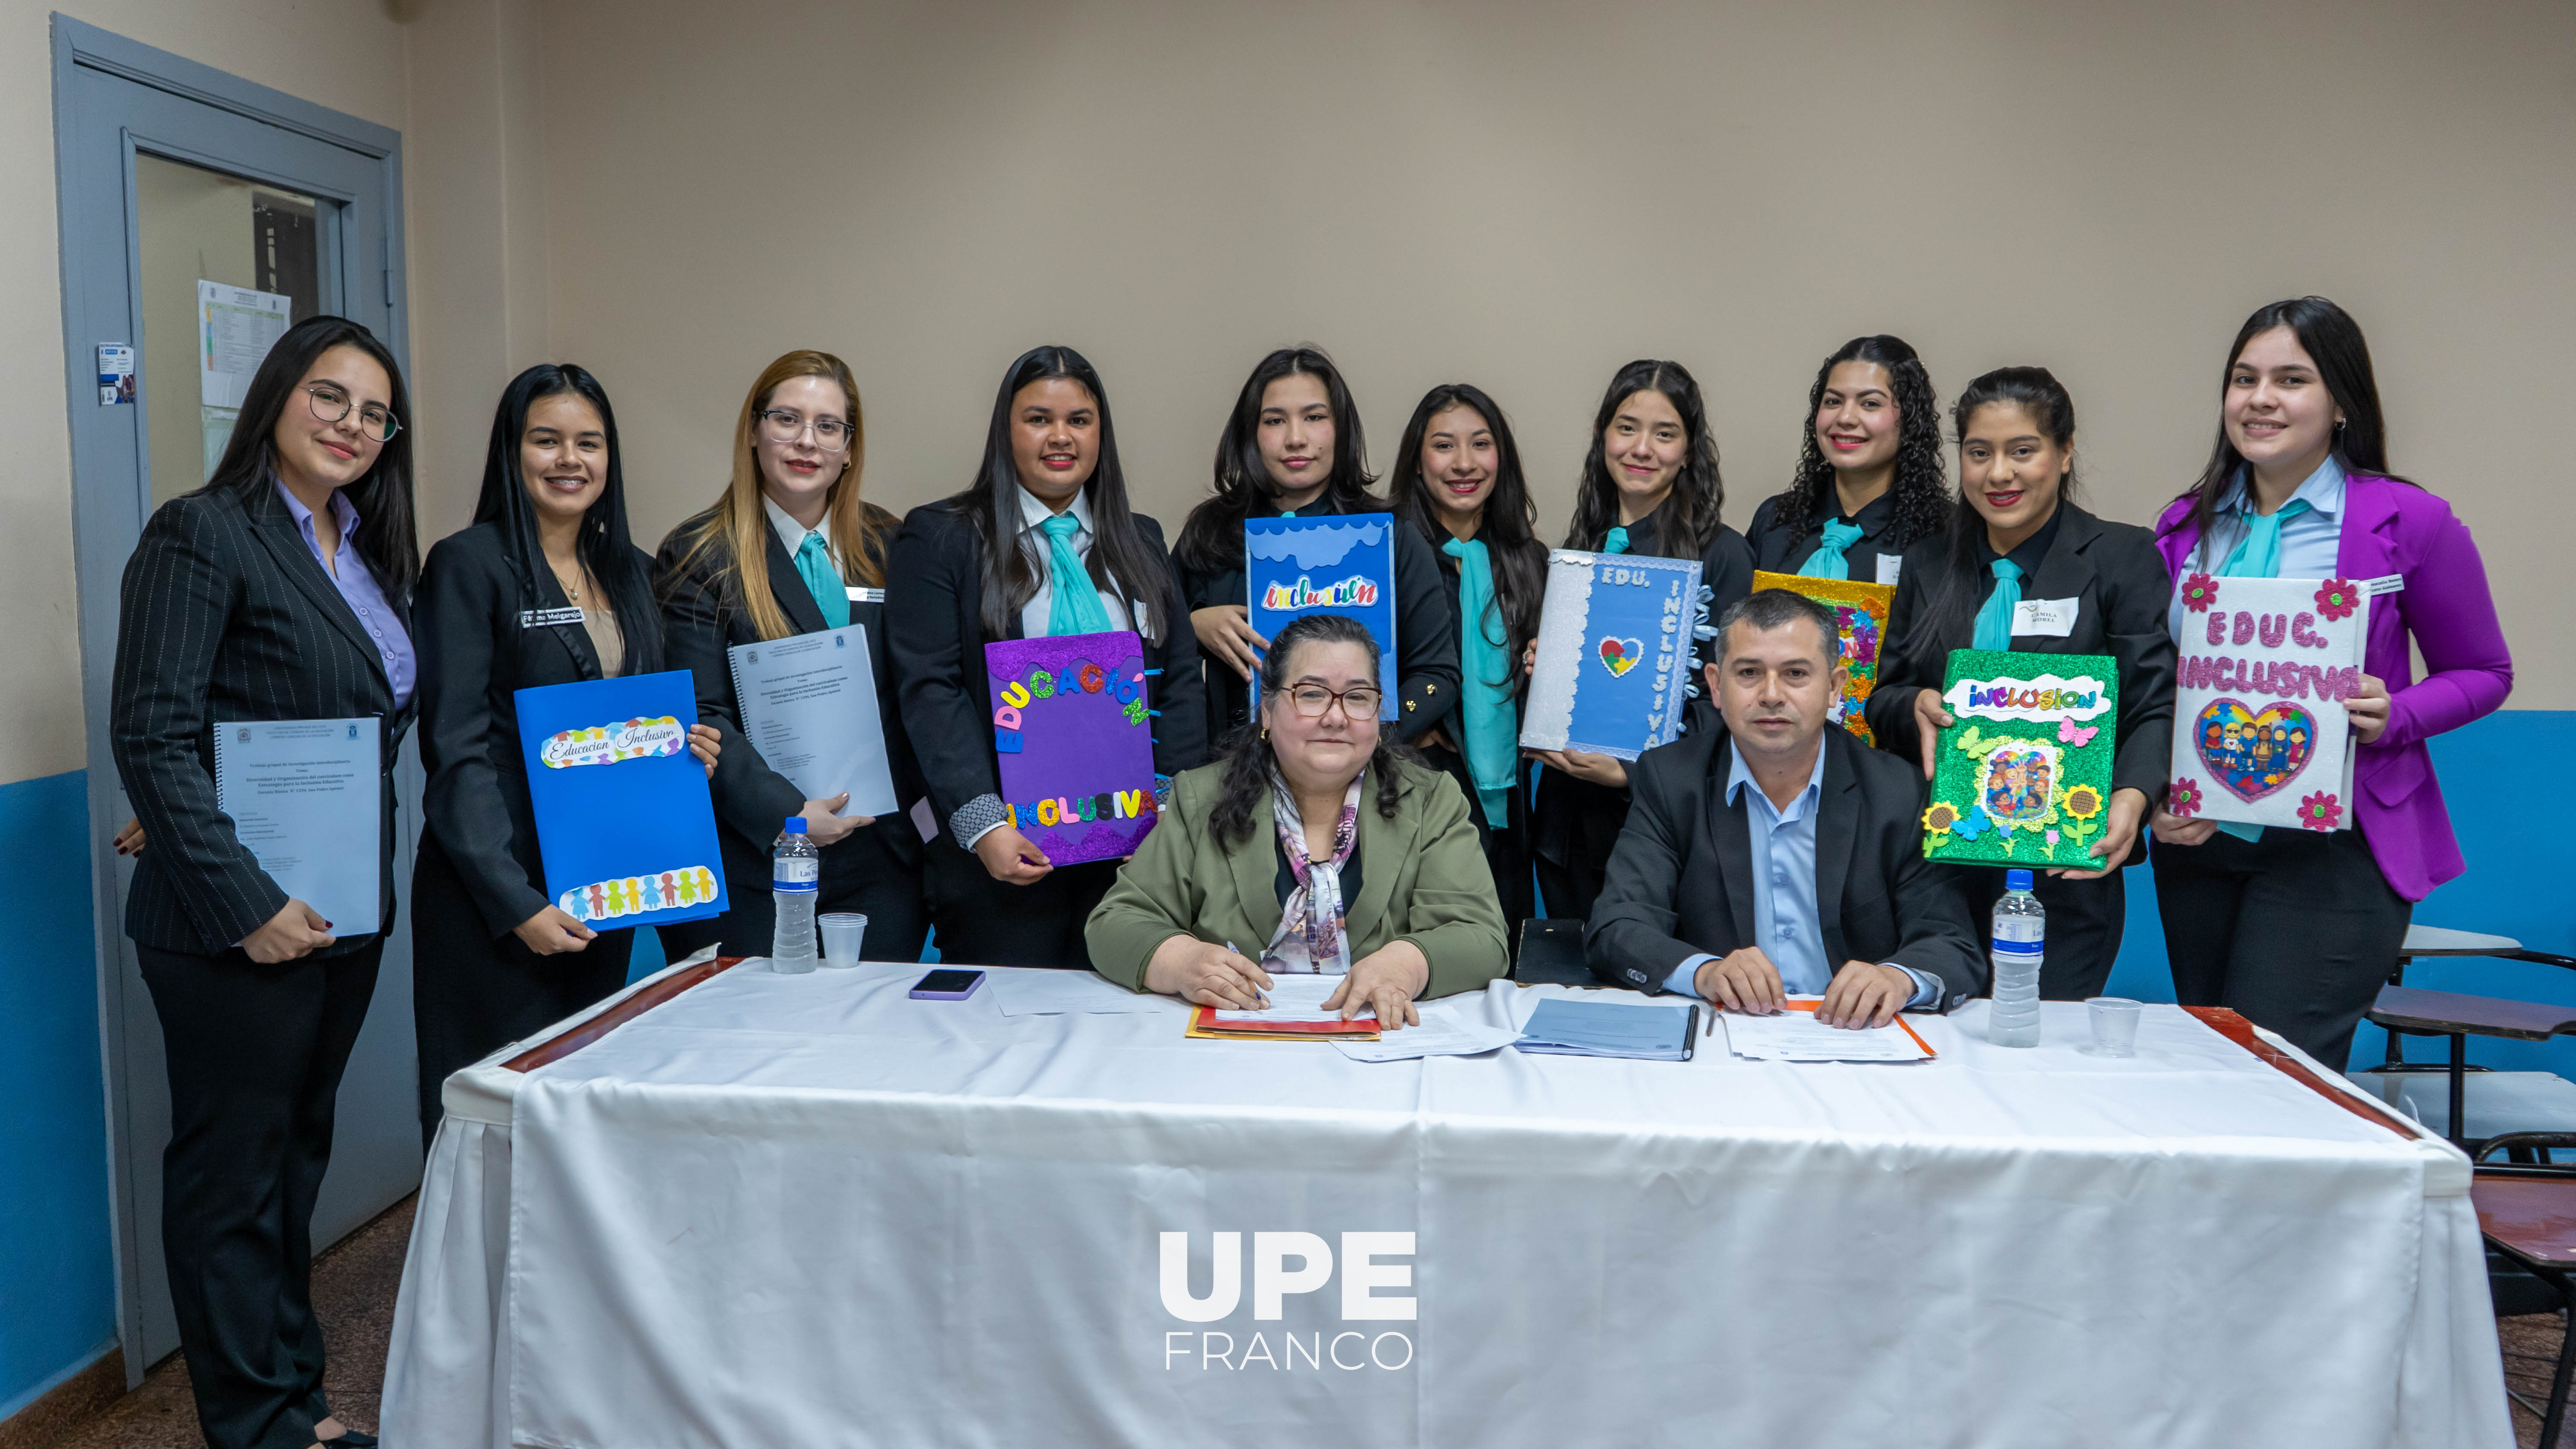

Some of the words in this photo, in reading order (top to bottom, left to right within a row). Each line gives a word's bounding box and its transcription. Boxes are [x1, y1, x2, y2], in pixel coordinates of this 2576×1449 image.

[1601, 567, 1650, 588] EDU.
[547, 611, 581, 620] Melgarejo
[2206, 611, 2329, 648] EDUC.
[1643, 580, 1681, 750] INCLUSIVA
[2176, 655, 2362, 702] INCLUSIVA
[994, 664, 1150, 754] EDUCACIÓN
[550, 741, 609, 760] Educacion
